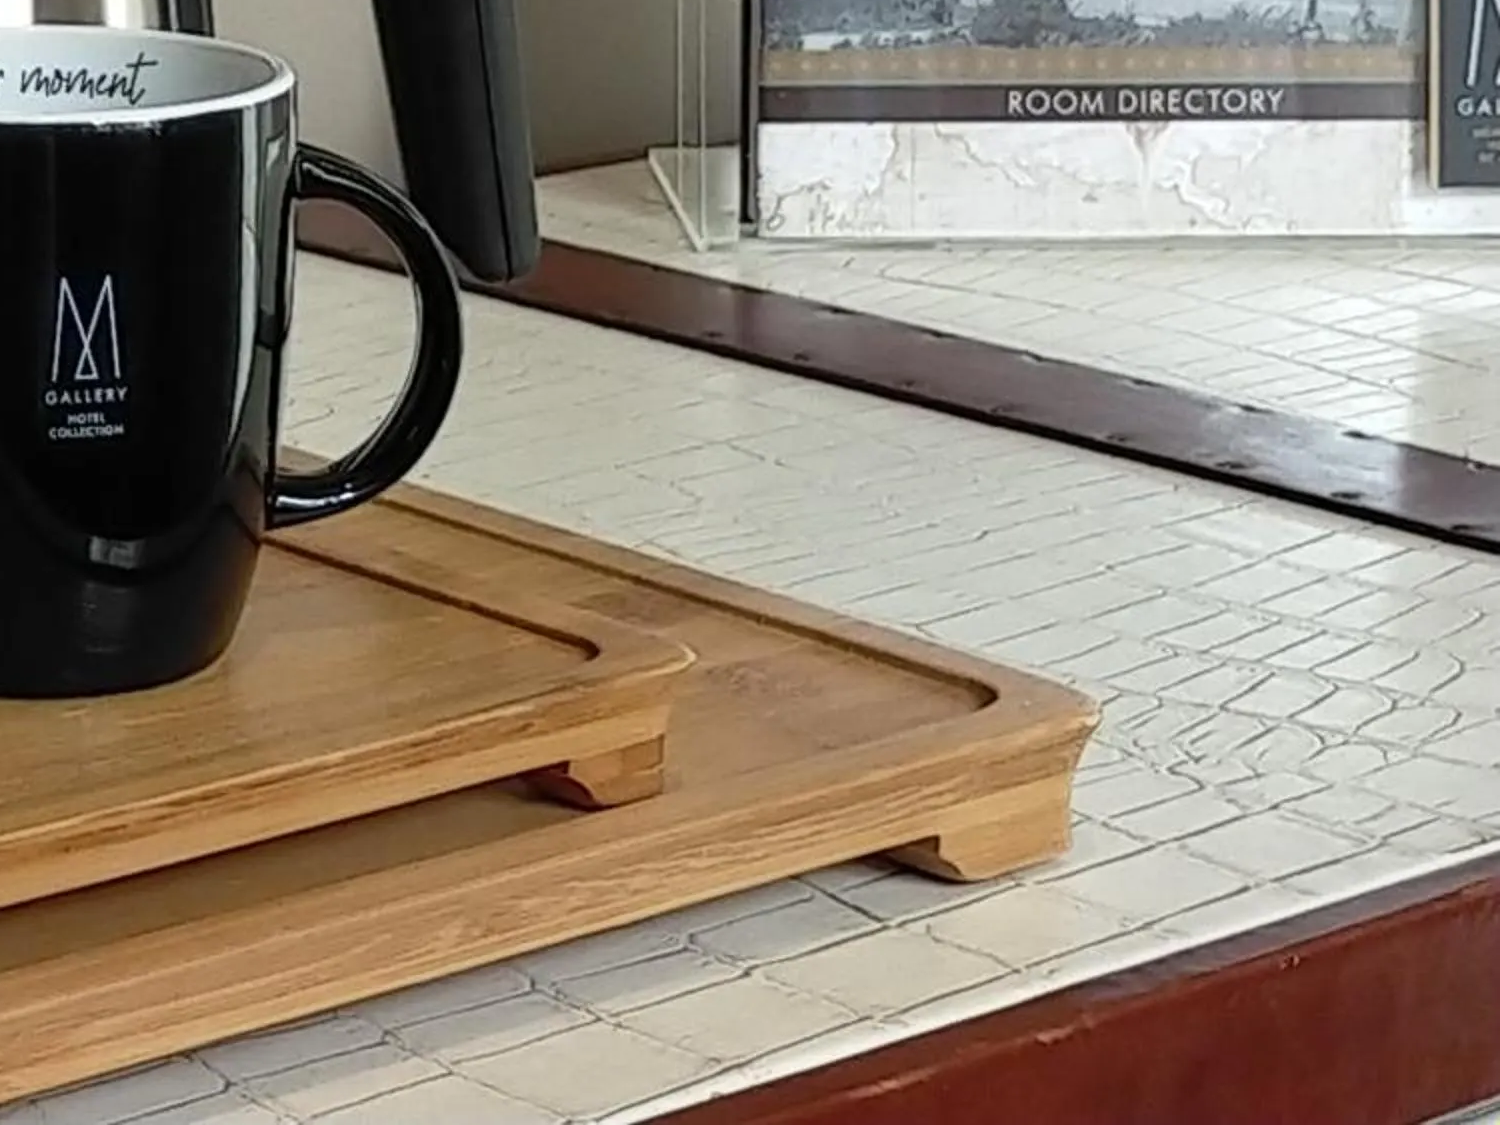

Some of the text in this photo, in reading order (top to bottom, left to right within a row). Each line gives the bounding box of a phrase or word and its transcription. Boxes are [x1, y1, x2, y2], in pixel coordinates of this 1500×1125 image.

[18, 52, 159, 106] moment
[1007, 88, 1285, 116] ROOM DIRECTORY
[44, 386, 129, 407] GALLERY
[67, 412, 106, 426] HOTEL
[49, 424, 125, 441] COLLECTION
